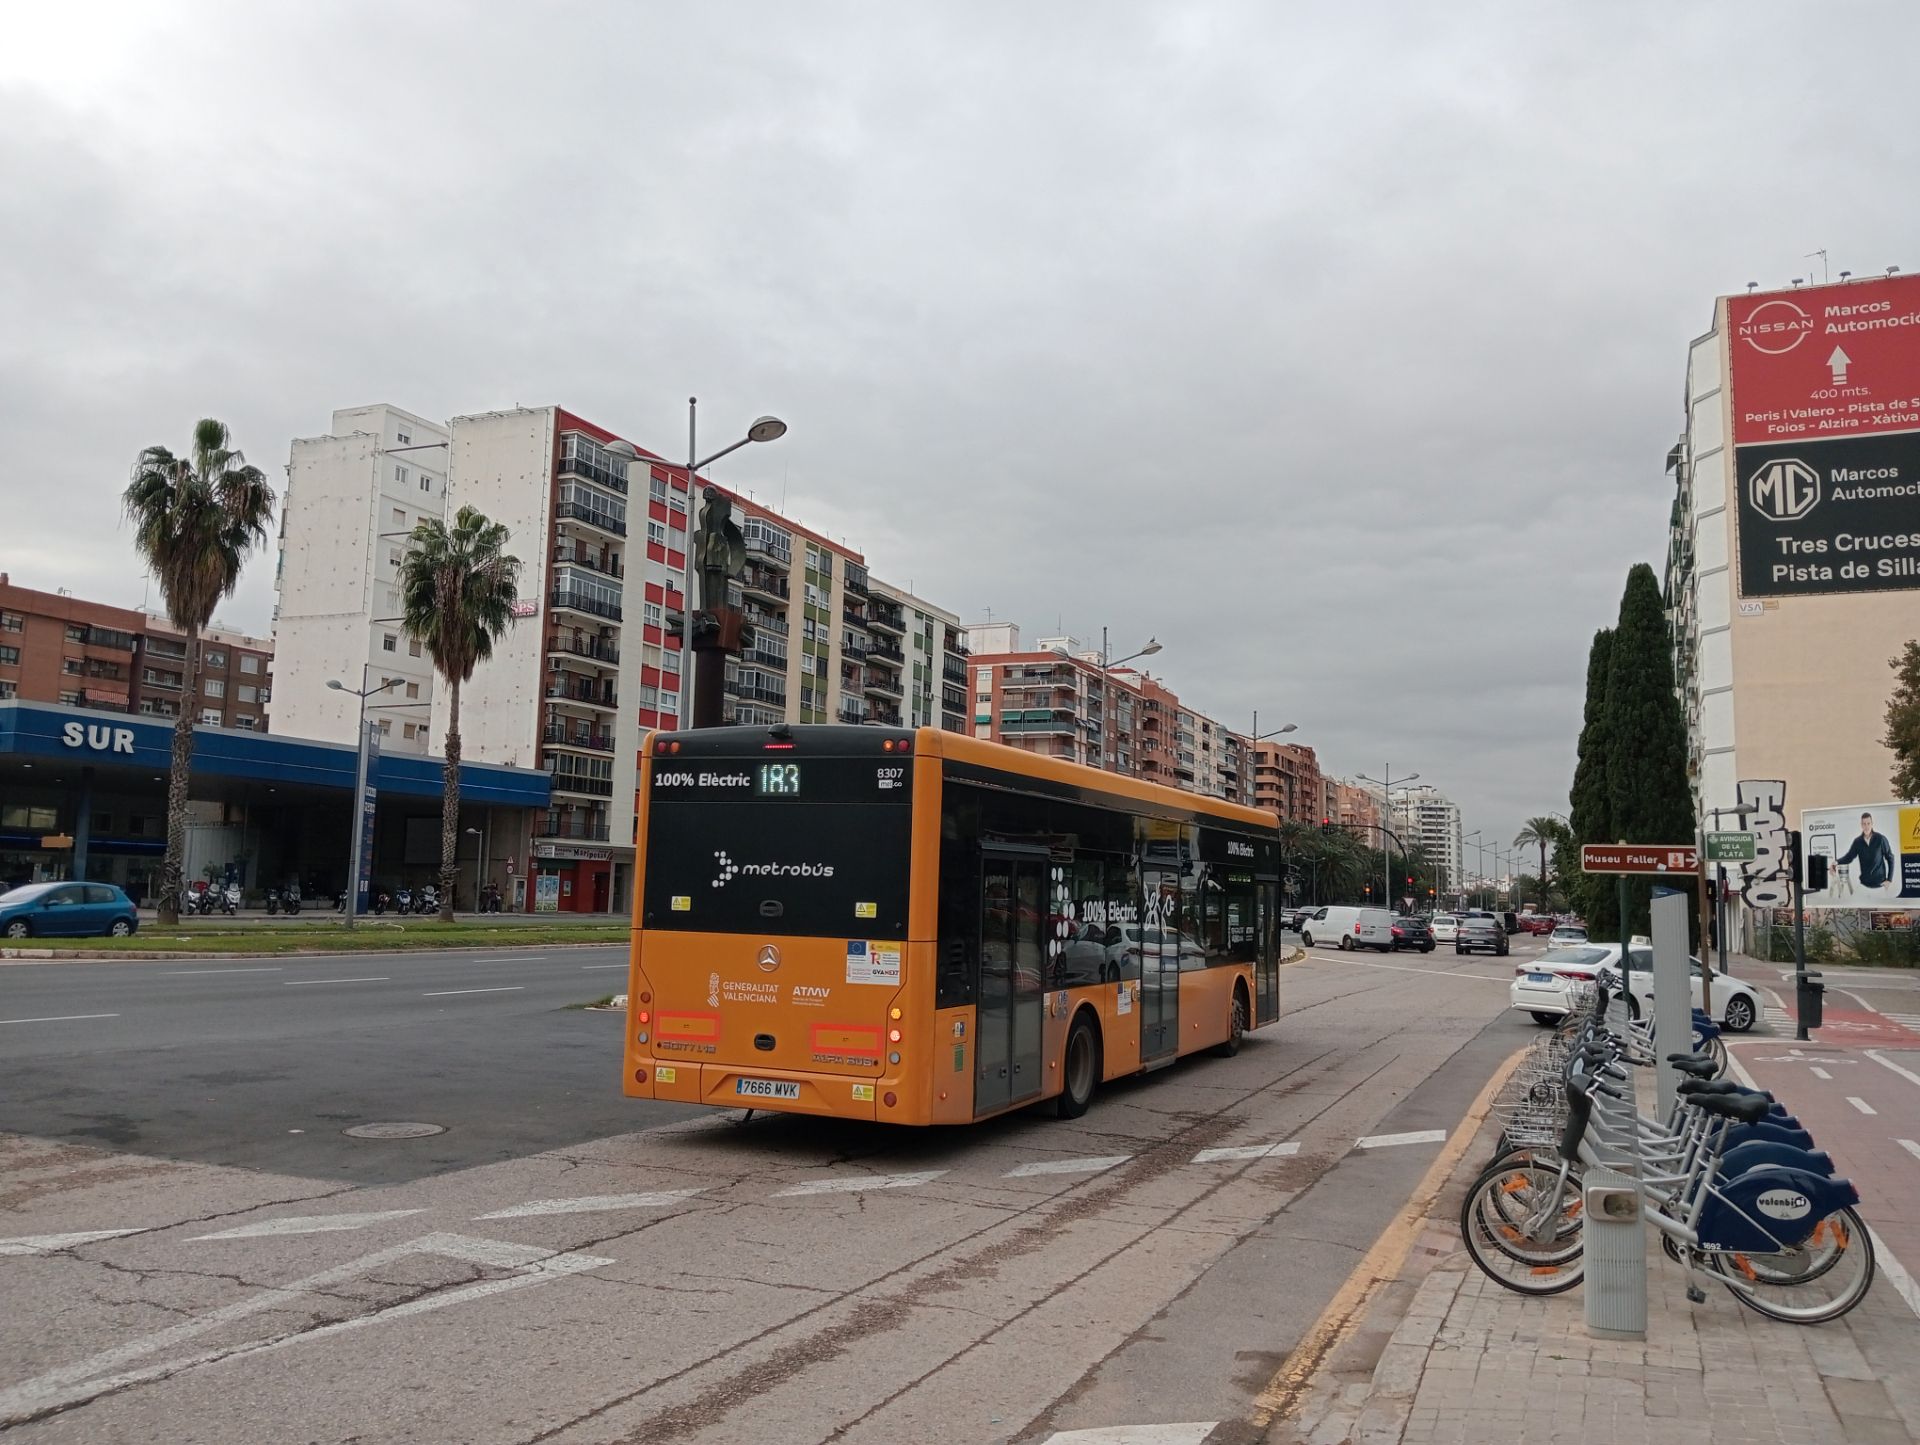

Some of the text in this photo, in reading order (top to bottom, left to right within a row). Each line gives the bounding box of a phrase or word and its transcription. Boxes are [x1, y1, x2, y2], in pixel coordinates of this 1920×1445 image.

[1824, 300, 1891, 318] Marcos
[1739, 319, 1814, 336] NISSAN
[1810, 386, 1872, 400] 400 mts.
[1745, 410, 1780, 422] Peris
[1790, 406, 1835, 419] Valero
[1848, 401, 1885, 413] Pista
[1889, 398, 1908, 409] de
[1768, 422, 1806, 433] Foios
[1818, 417, 1859, 430] Alzira
[1872, 412, 1919, 424] Xàtiva
[1831, 467, 1899, 483] Marcos
[1755, 464, 1814, 516] MG
[1776, 533, 1920, 555] Tres Cruces
[1773, 563, 1833, 583] Pista
[1839, 561, 1870, 579] de
[62, 721, 136, 754] SUR
[655, 772, 751, 787] 100% Elèctric
[877, 768, 904, 778] 8307
[1585, 854, 1659, 864] Museu Faller
[742, 861, 835, 878] metrobús
[1082, 899, 1138, 922] 100% Elèctric
[722, 981, 779, 993] GENERALITAT
[723, 992, 777, 1004] VALENCIANA
[743, 1079, 797, 1097] 7666 MVK
